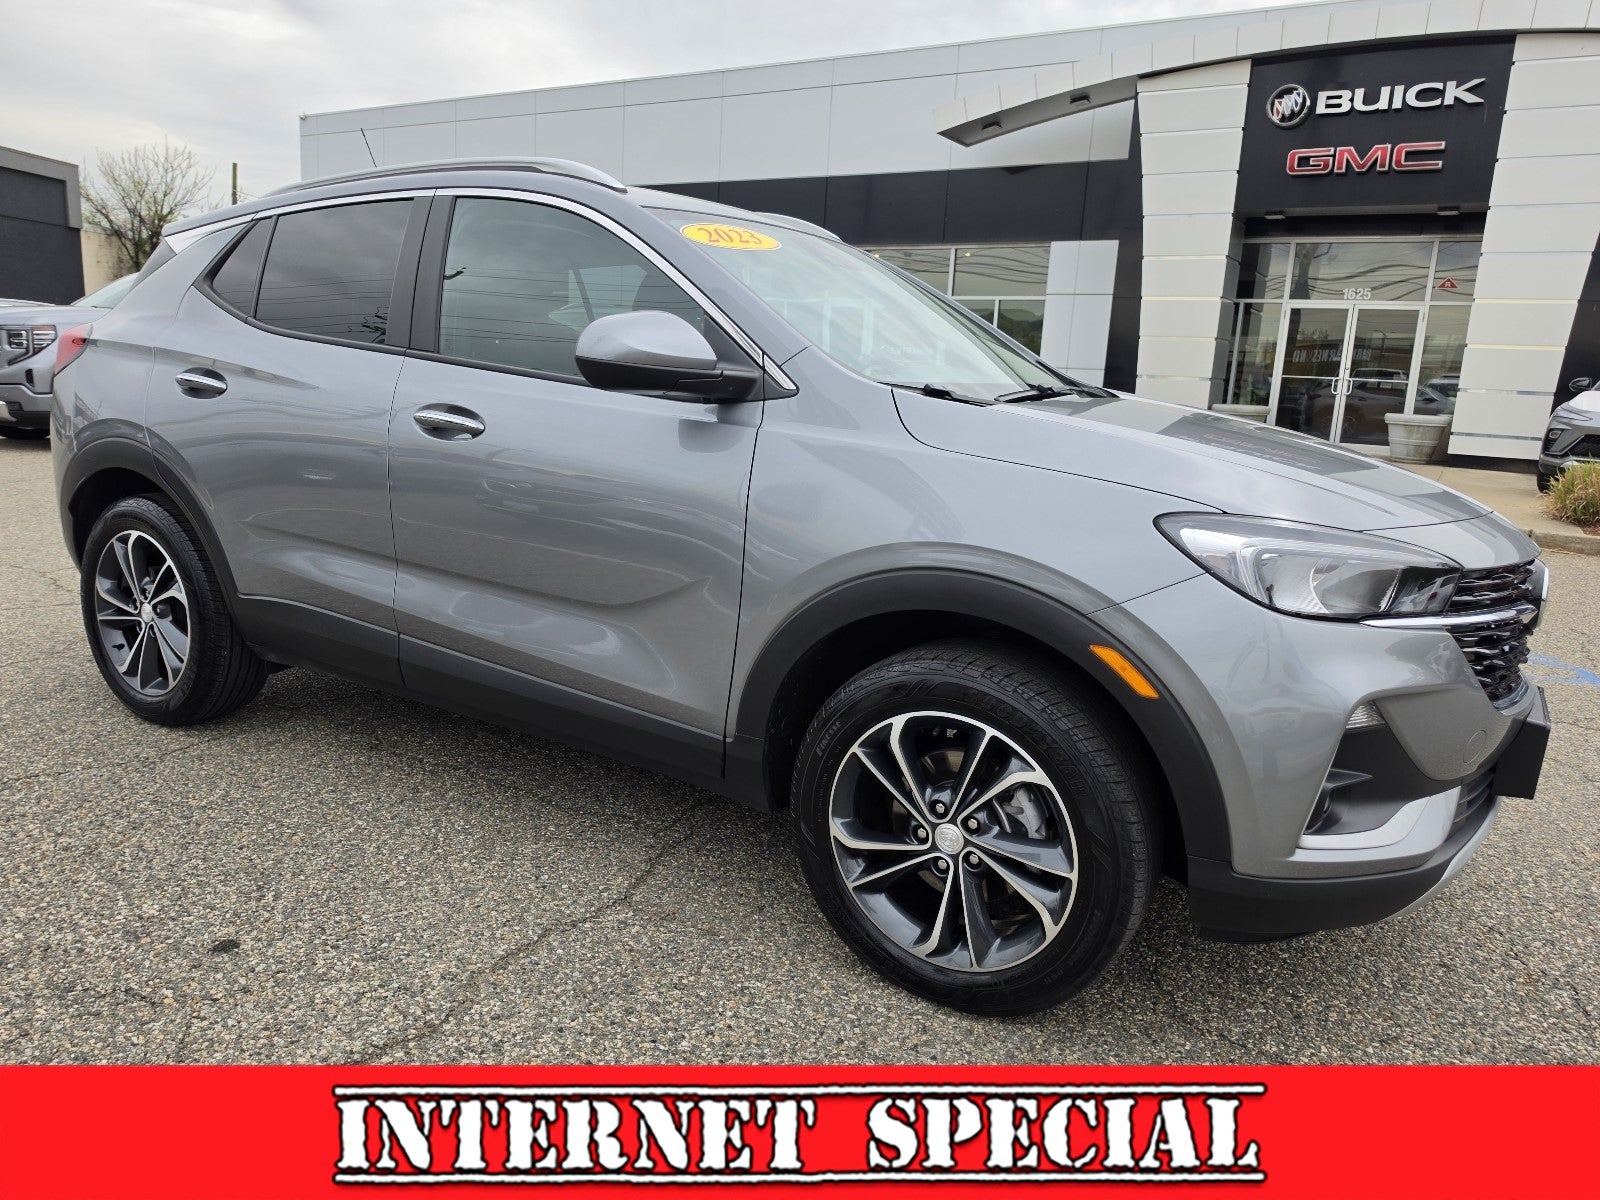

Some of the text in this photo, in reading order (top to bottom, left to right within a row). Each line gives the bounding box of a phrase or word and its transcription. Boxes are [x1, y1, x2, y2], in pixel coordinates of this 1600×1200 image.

[1315, 77, 1486, 114] BUICK
[1287, 141, 1446, 175] GMC
[697, 227, 763, 245] 2023
[1342, 287, 1372, 300] 1625
